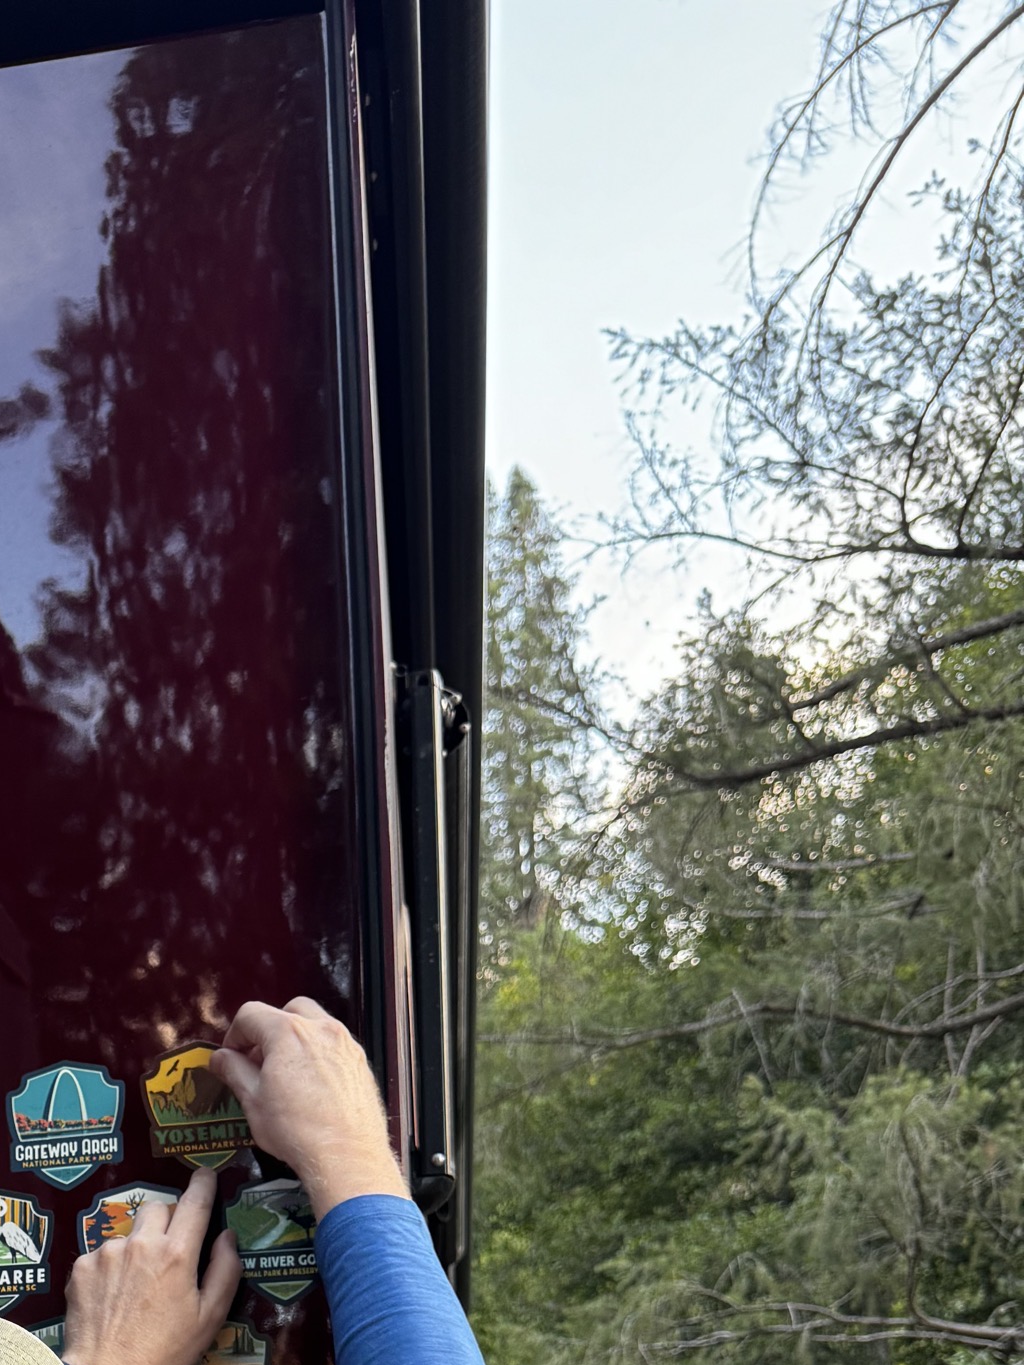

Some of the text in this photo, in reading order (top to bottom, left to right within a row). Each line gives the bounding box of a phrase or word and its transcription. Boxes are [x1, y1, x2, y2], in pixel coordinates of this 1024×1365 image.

[154, 1122, 247, 1145] YOSEMIT
[15, 1137, 118, 1162] GATEWAY ARCH
[164, 1144, 208, 1154] NATIONAL
[212, 1140, 235, 1149] PARK
[22, 1153, 113, 1169] NATIONAL PARK MO
[259, 1255, 295, 1268] RIVER
[263, 1269, 281, 1277] PARK
[282, 1268, 288, 1276] &
[289, 1267, 318, 1275] PRESERV
